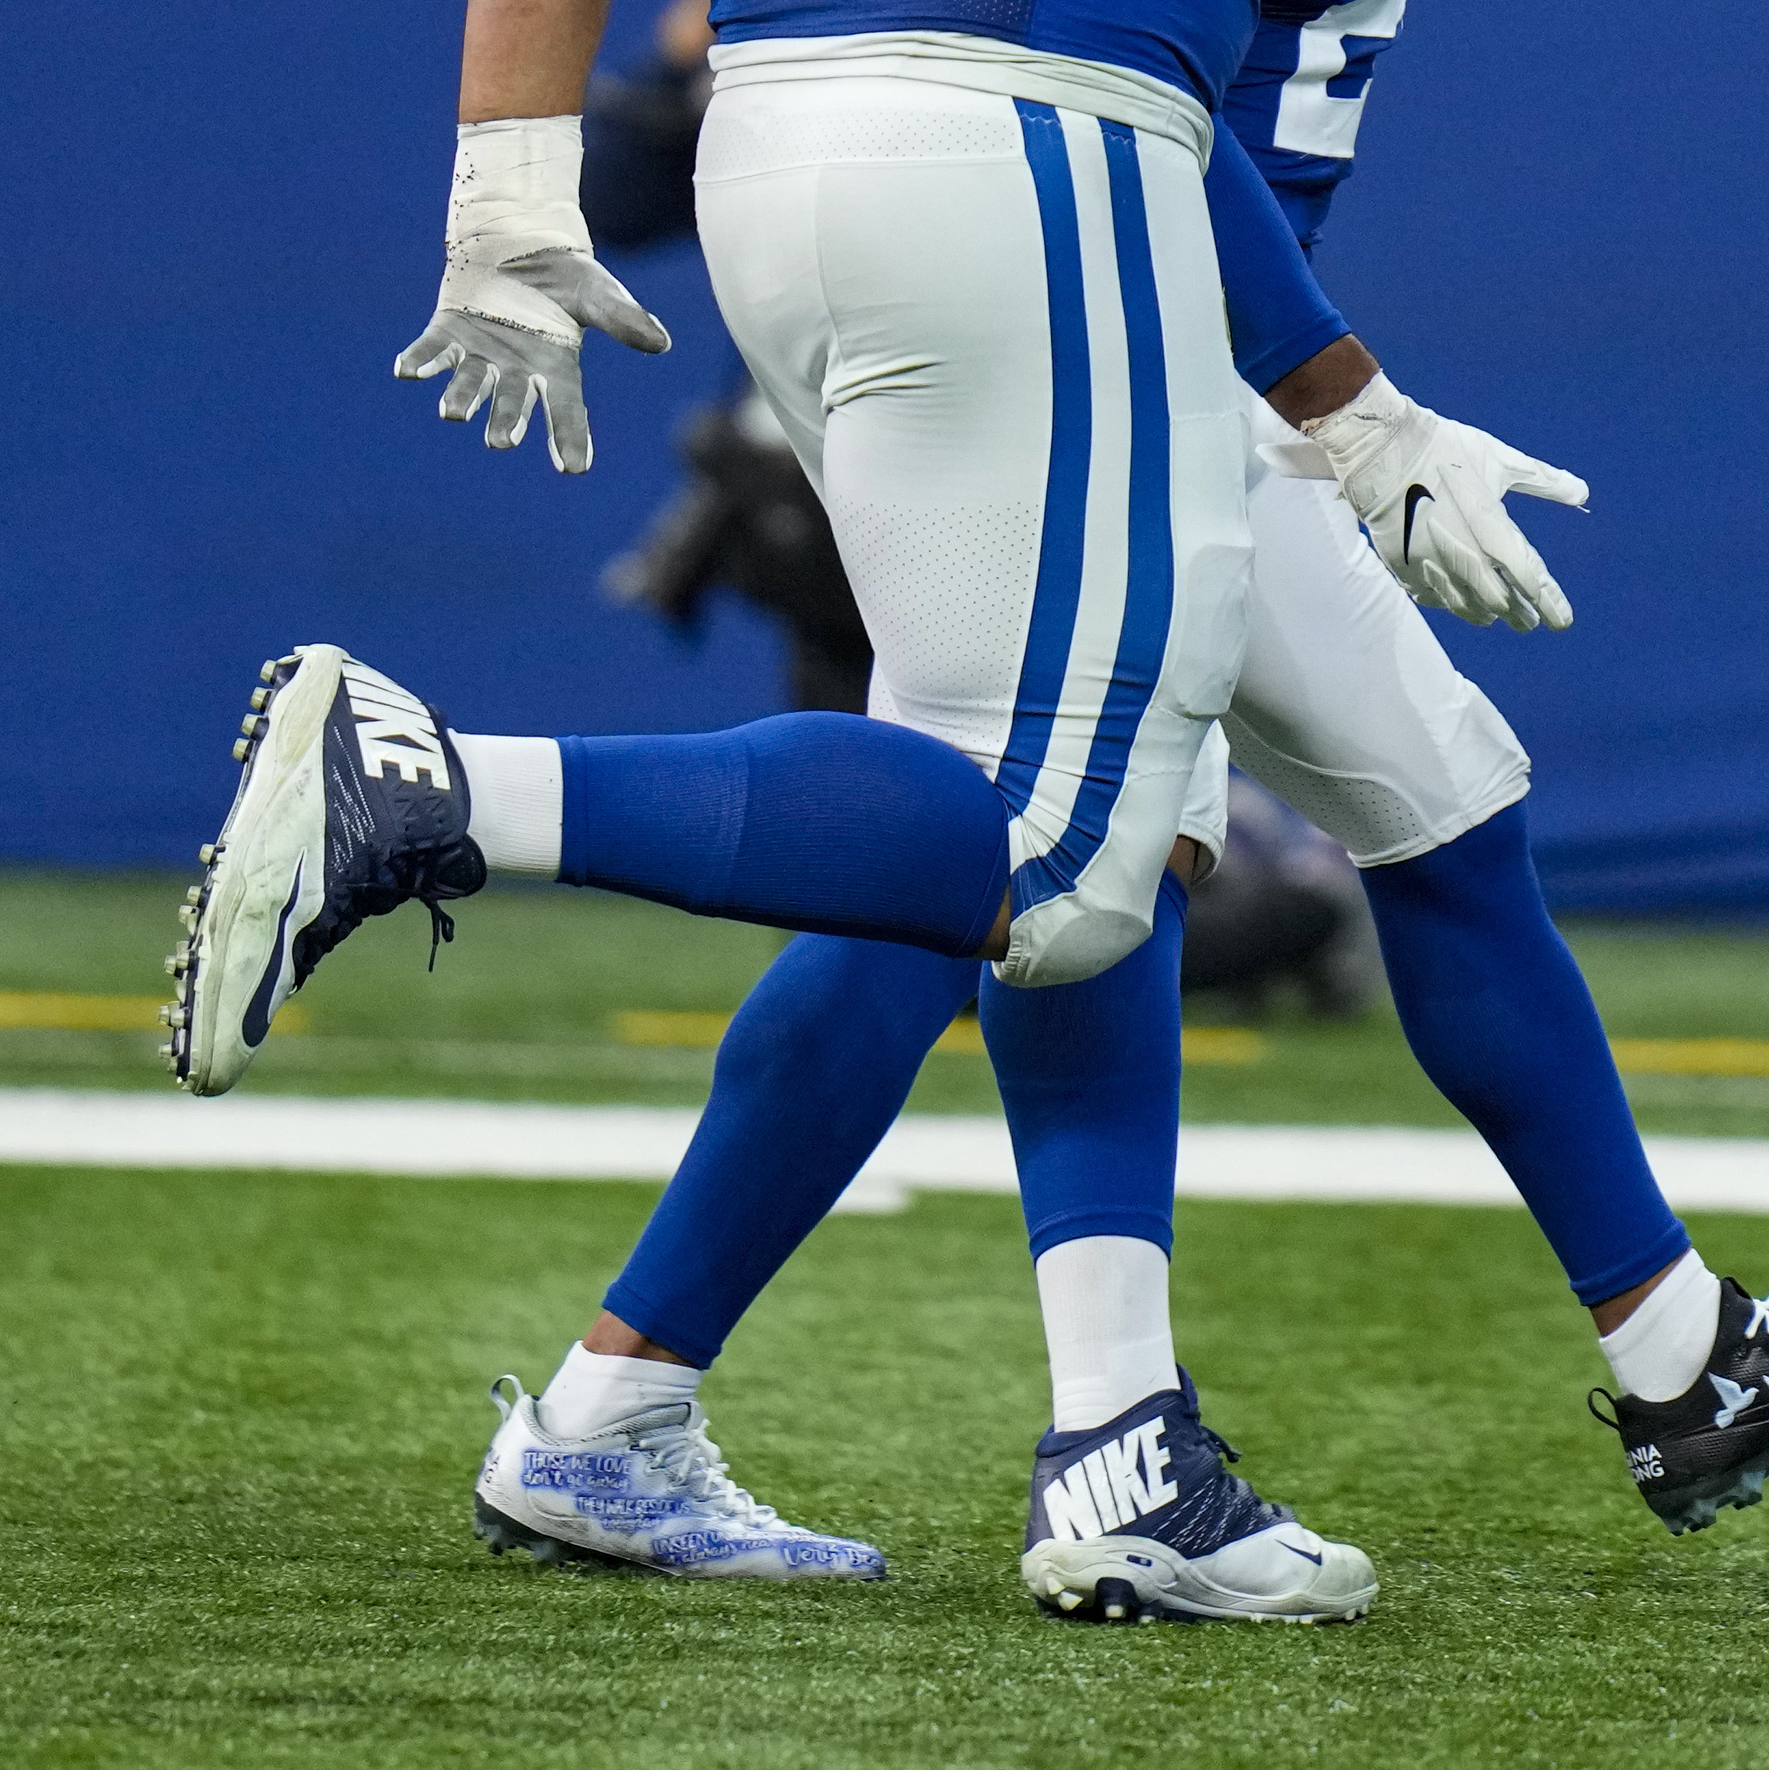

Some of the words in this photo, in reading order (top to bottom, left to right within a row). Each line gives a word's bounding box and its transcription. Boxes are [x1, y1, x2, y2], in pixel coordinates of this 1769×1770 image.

[341, 657, 451, 791] NIKE
[523, 1452, 566, 1470] THOSE
[571, 1454, 593, 1472] WE
[596, 1457, 632, 1475] LOVE
[1043, 1416, 1179, 1541] NIKE
